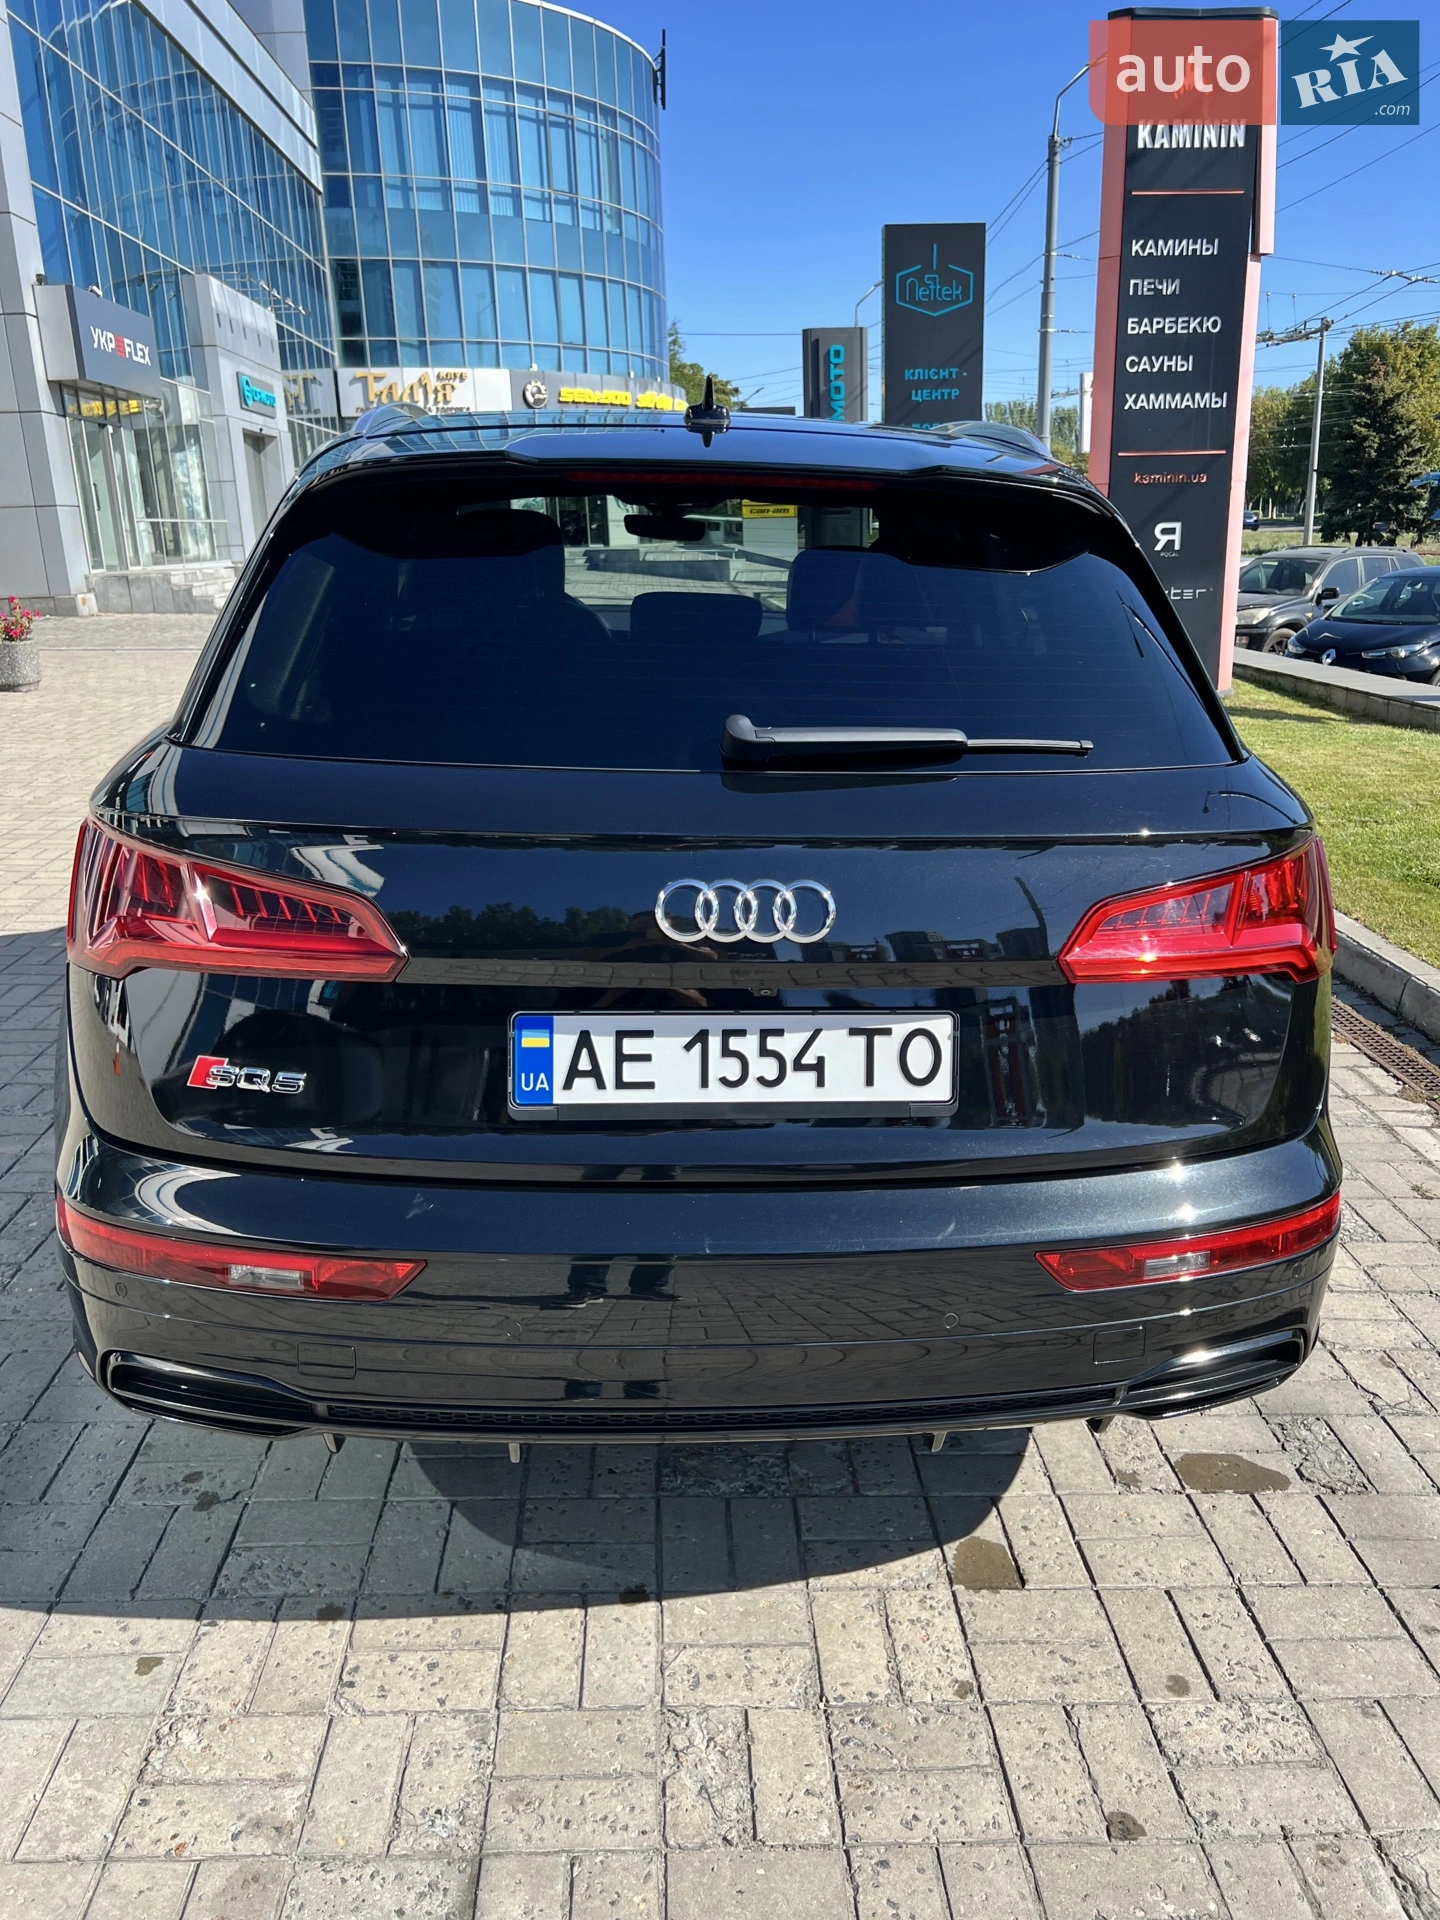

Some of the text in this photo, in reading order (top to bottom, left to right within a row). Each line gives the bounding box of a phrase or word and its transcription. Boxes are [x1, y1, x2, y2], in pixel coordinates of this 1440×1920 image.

[1131, 238, 1219, 256] КАМИНЫ
[1129, 278, 1180, 296] ПЕЧИ
[1127, 315, 1222, 335] БАРБЕКЮ
[1125, 355, 1194, 373] САУНЫ
[911, 388, 960, 402] ЦЕНТР
[1124, 392, 1228, 410] ХАММАМЫ
[1133, 472, 1208, 484] kaminin.ua
[562, 1026, 943, 1090] AE 1554 TO
[206, 1065, 307, 1094] SQ5
[520, 1072, 550, 1092] UA
